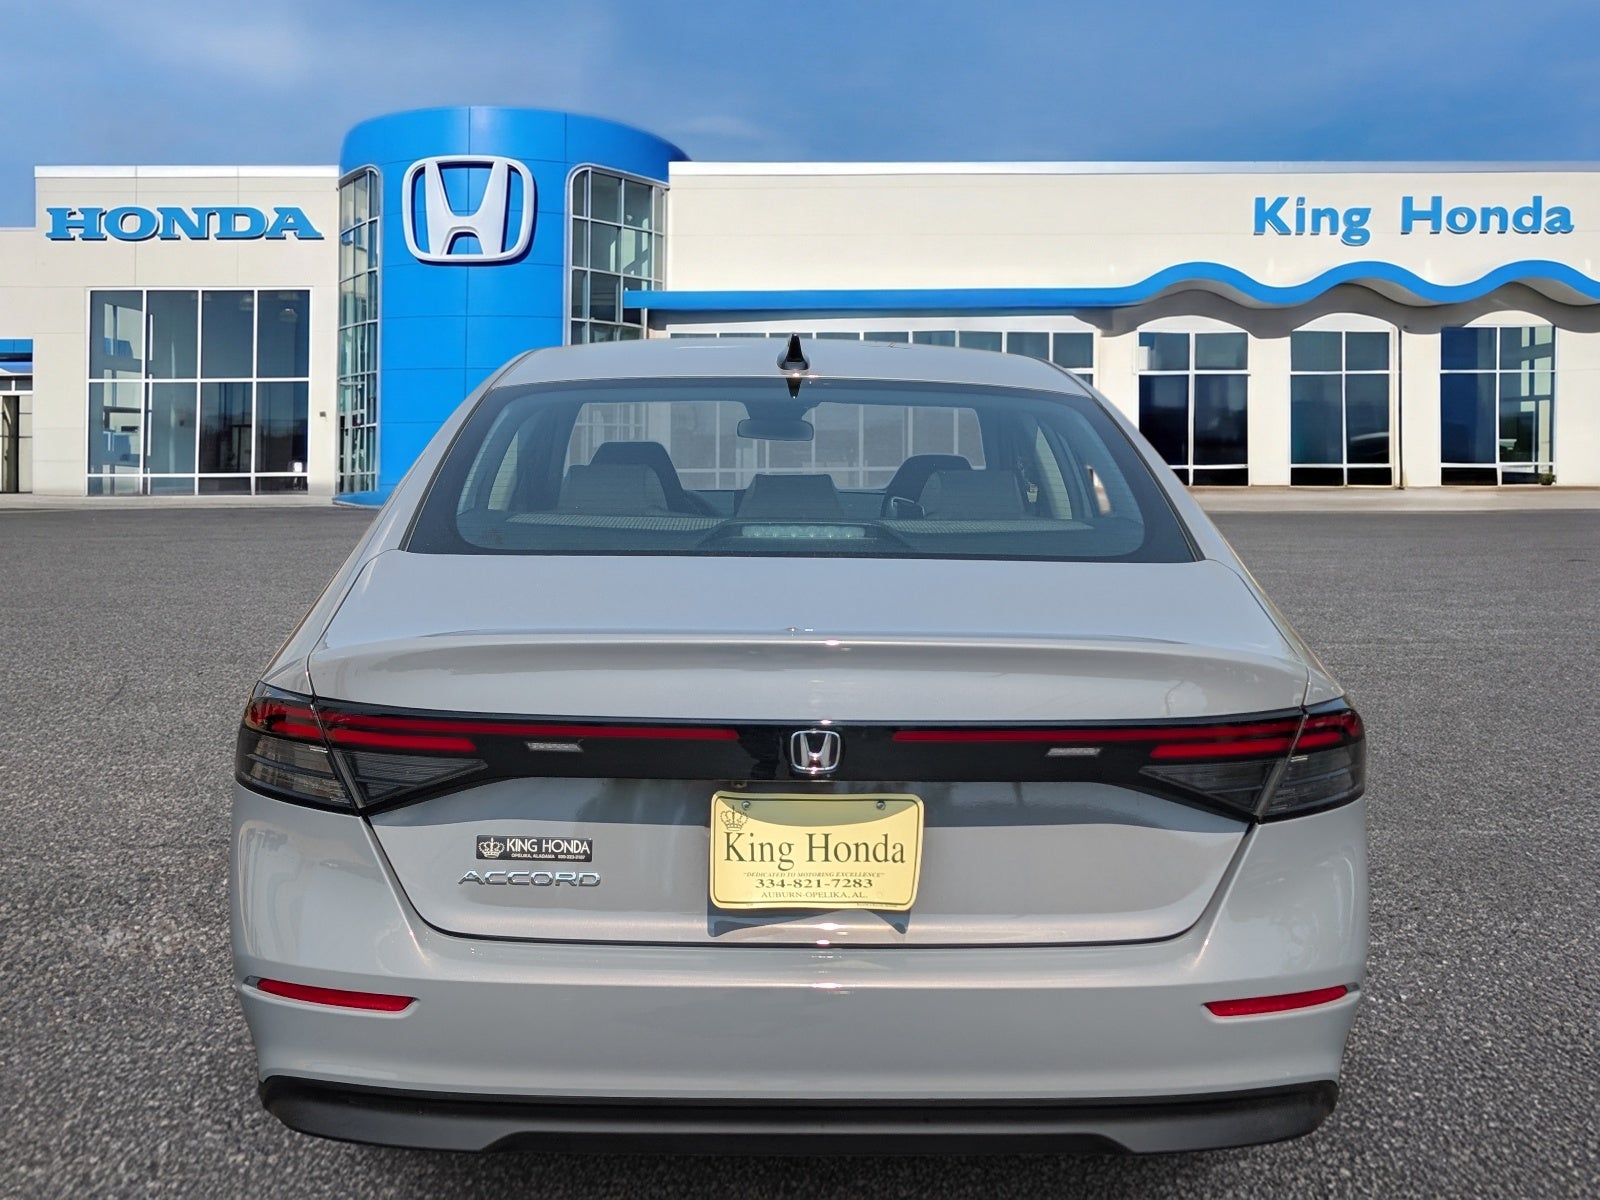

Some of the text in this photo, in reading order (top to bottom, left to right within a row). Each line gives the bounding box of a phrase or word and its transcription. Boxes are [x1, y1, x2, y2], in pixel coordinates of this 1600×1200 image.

[46, 206, 325, 241] HONDA
[1253, 195, 1575, 246] King Honda
[506, 838, 590, 854] KING HONDA
[723, 831, 906, 871] King Honda
[458, 870, 601, 887] ACCORD
[755, 879, 873, 888] 334-821-7283
